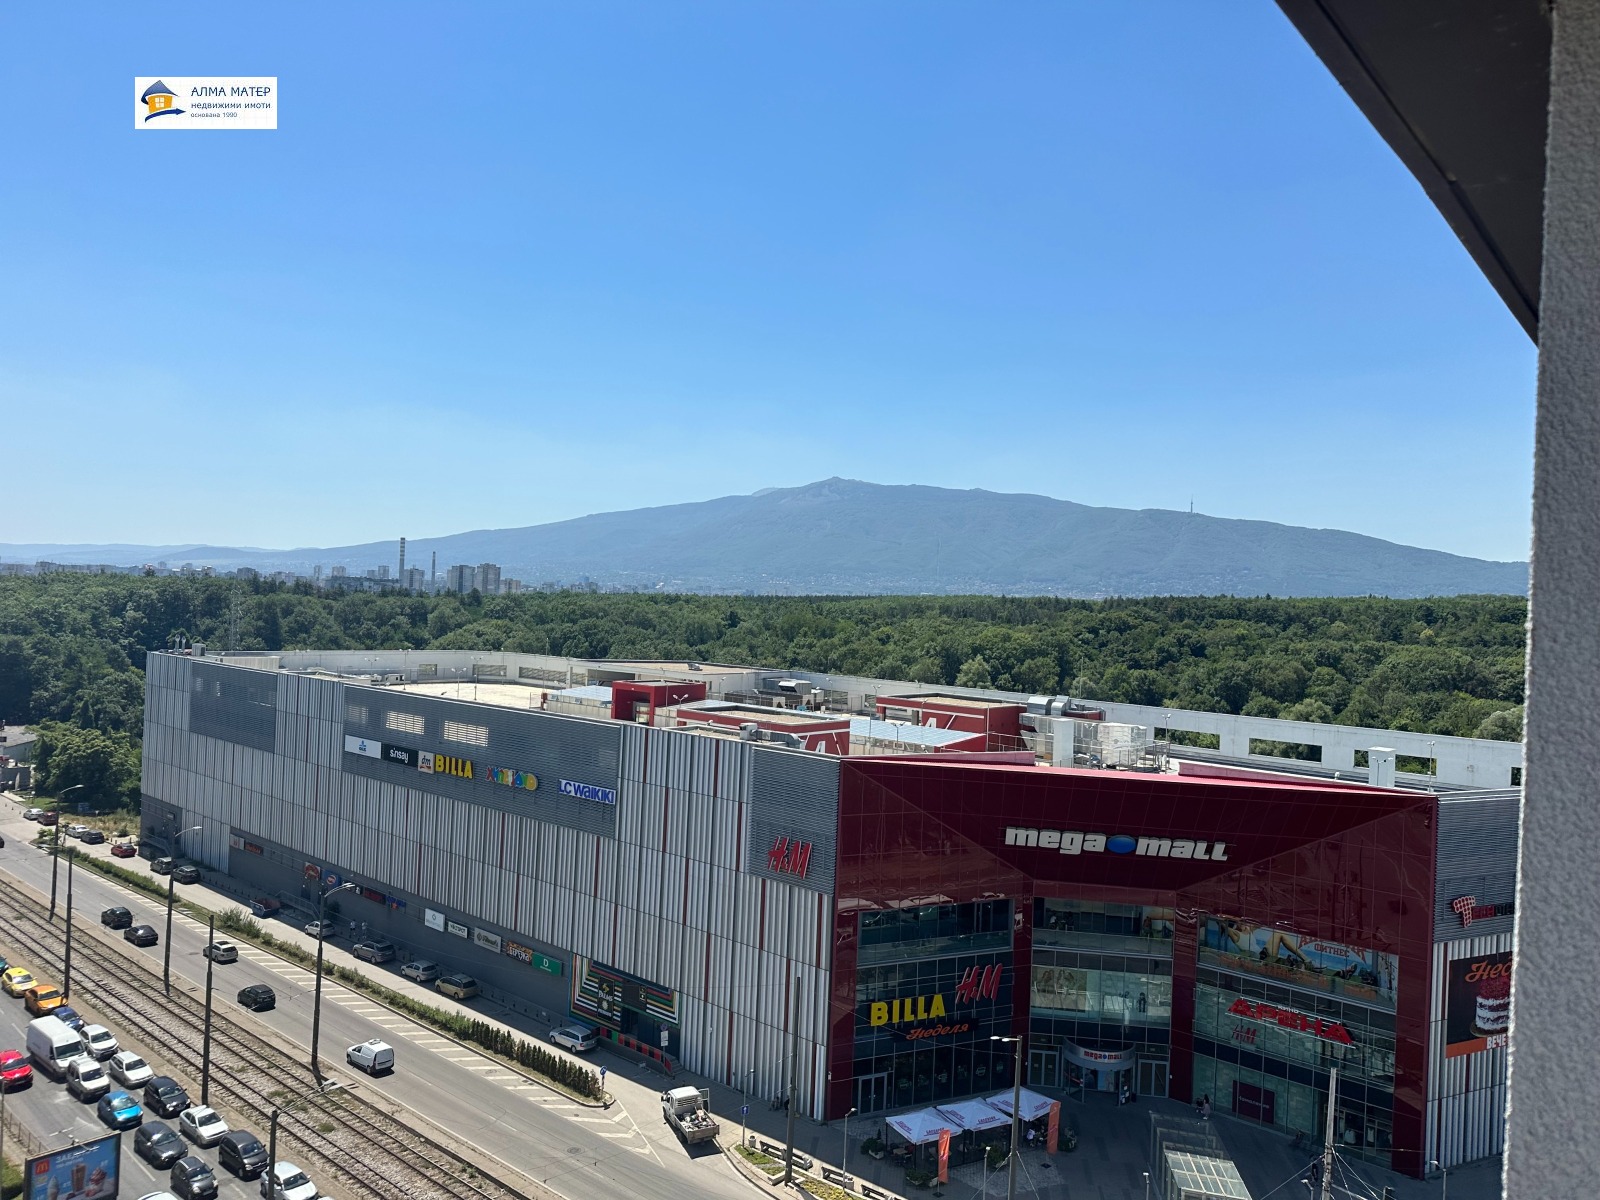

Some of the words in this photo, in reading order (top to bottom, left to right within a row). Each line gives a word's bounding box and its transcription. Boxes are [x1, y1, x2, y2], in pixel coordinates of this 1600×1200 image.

[435, 754, 473, 779] BILLA
[559, 781, 572, 794] LC
[767, 835, 812, 880] H&M
[1005, 826, 1107, 855] mega
[1135, 836, 1228, 861] mall
[1314, 943, 1350, 958] ФИТНЕС
[956, 963, 1003, 1005] H&M
[870, 993, 946, 1027] BILLA
[1227, 998, 1353, 1044] АРЕНА
[906, 1022, 969, 1040] Неделя
